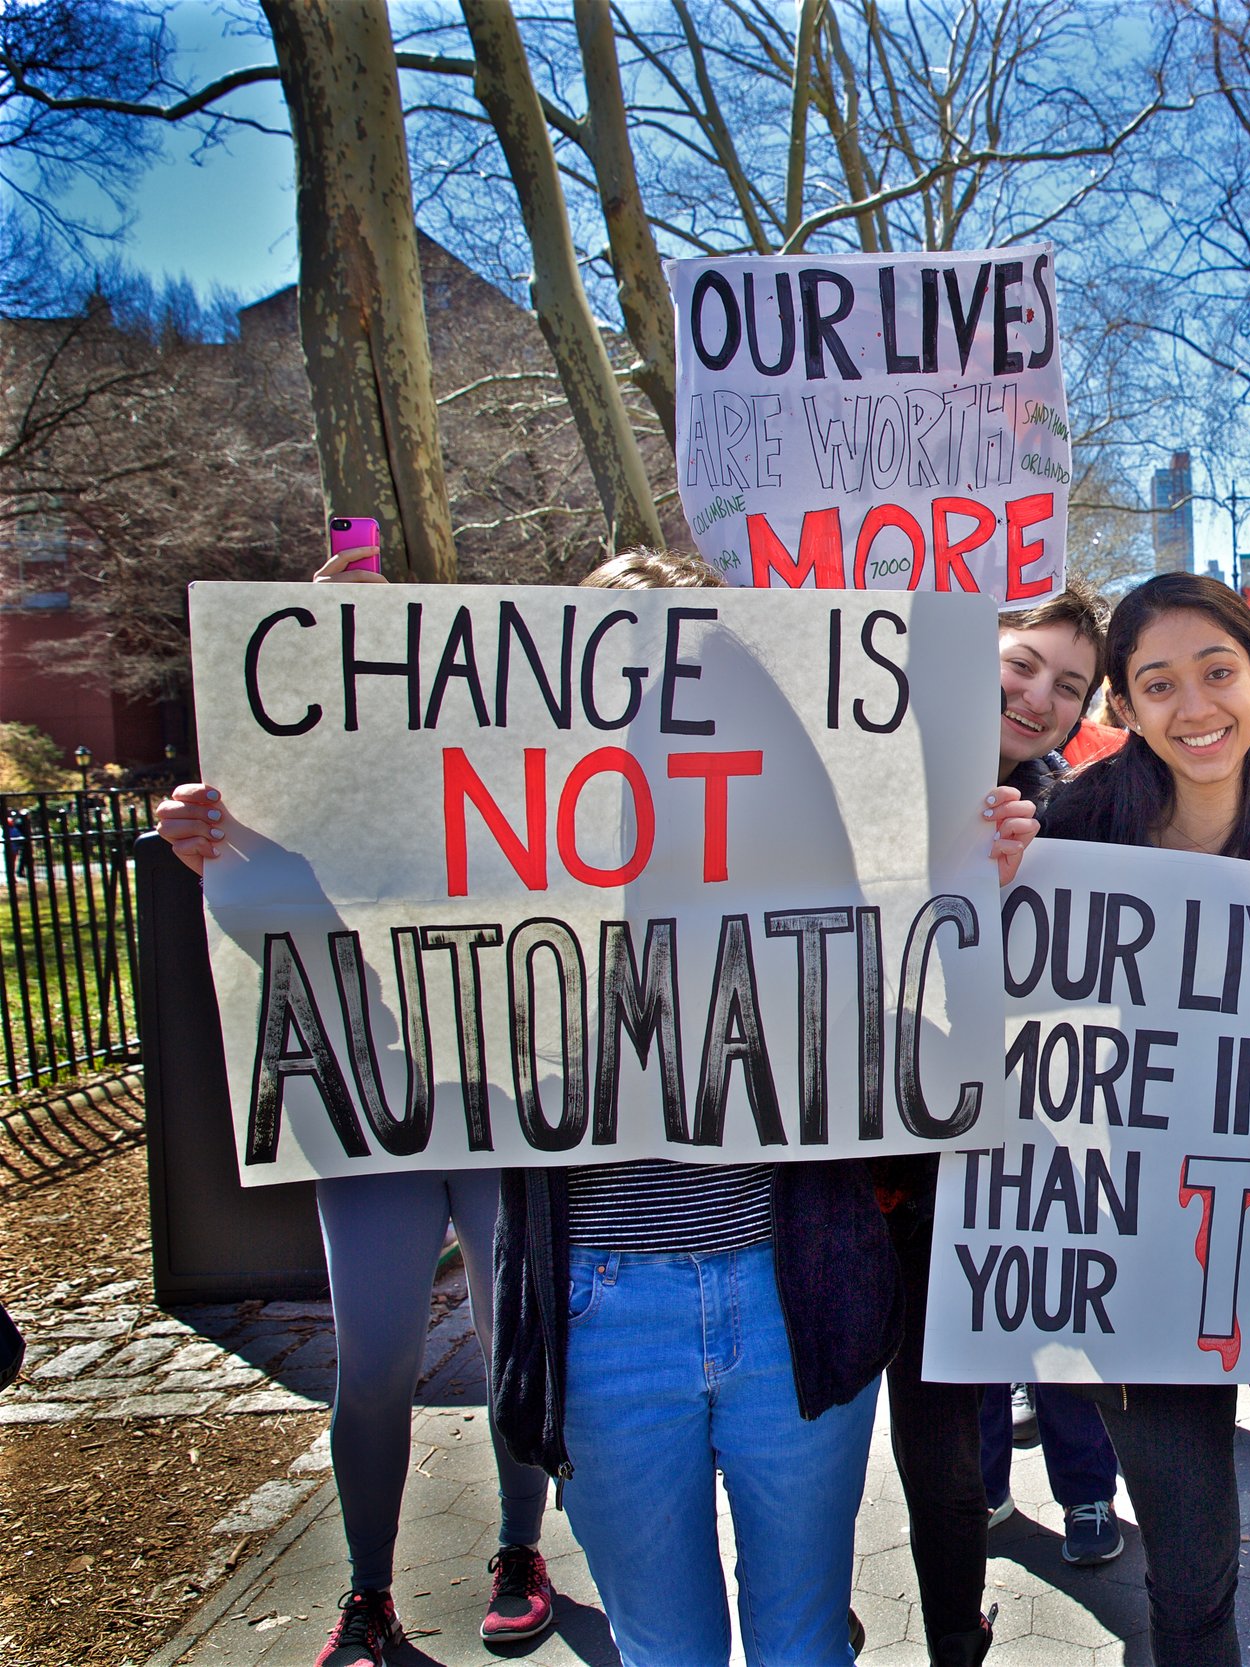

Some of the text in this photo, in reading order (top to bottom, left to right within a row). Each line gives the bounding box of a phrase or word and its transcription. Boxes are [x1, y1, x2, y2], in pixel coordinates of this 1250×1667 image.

[690, 254, 1053, 380] OUR LIVES
[686, 383, 1018, 494] ARE WORTH
[1020, 453, 1070, 484] ORLANDO
[692, 494, 746, 536] COLUMBINE
[745, 492, 1054, 601] MORE
[870, 557, 911, 580] 7000
[244, 600, 910, 736] CHANGE IS
[442, 746, 763, 896] NOT
[1001, 884, 1156, 1006] OUR
[244, 895, 984, 1166] AUTOMATIC
[955, 1141, 1141, 1236] THAN
[954, 1244, 1118, 1334] YOUR
